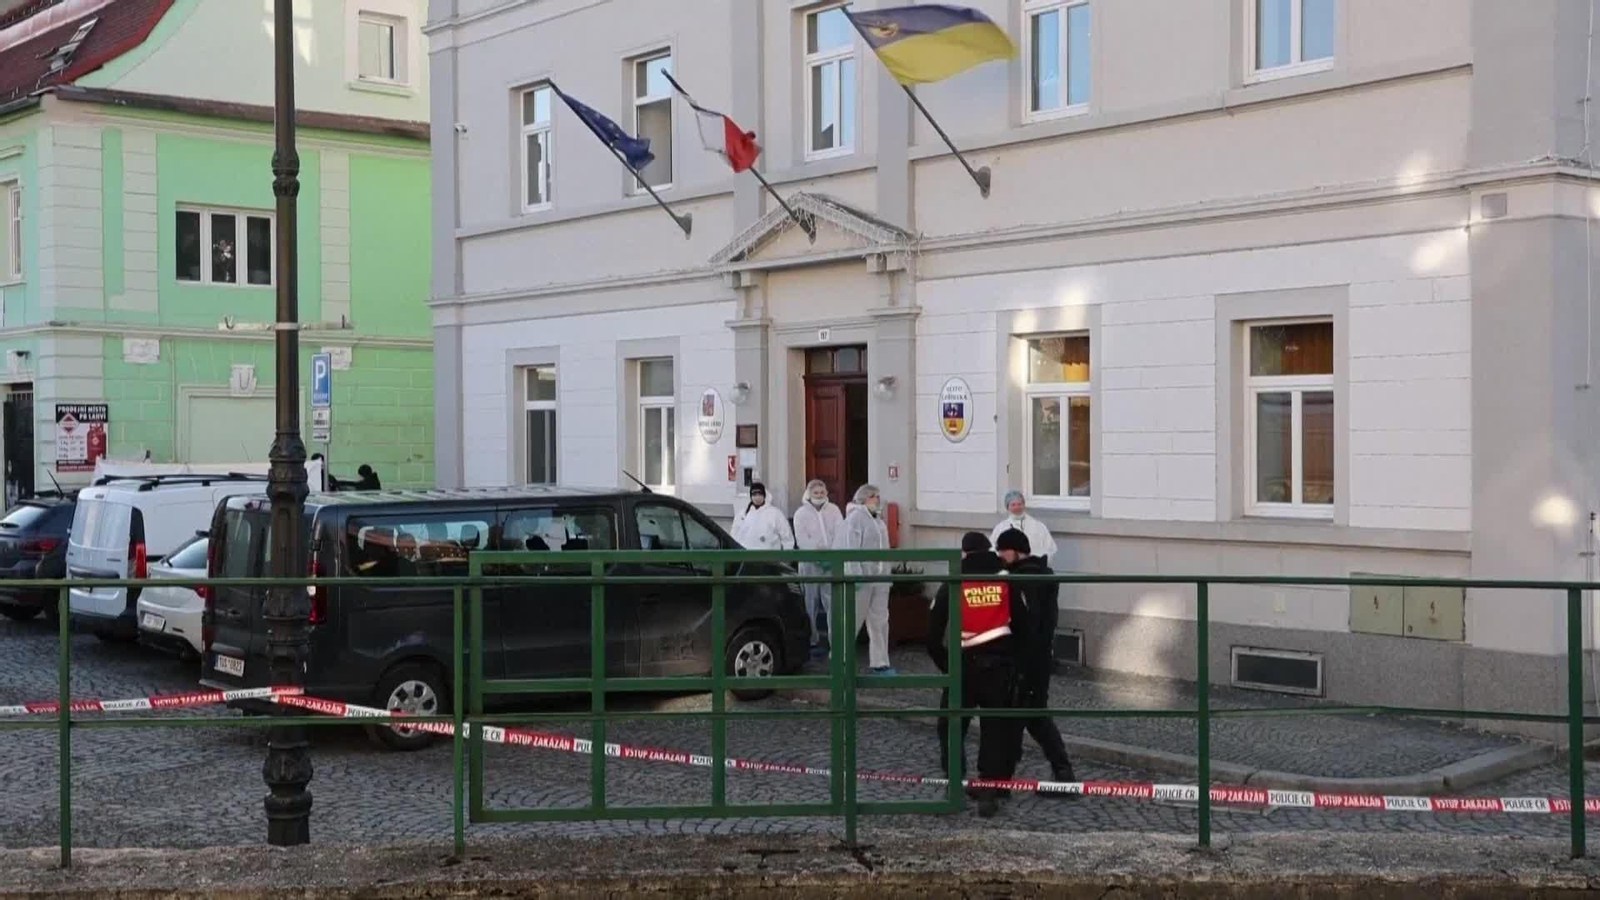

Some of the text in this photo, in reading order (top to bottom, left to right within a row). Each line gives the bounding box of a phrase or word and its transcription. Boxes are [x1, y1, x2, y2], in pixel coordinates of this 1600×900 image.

[315, 360, 326, 390] P
[964, 586, 1003, 597] POLICIE
[966, 594, 1002, 604] VELITEL
[509, 732, 533, 745] VSTUP
[624, 746, 648, 759] VSTUP
[1088, 786, 1111, 795] VSTUP
[1154, 788, 1183, 799] POLICIE
[1184, 787, 1196, 799] ČR
[1270, 793, 1299, 804] POLICIE
[1318, 794, 1342, 806] VSTUP
[1386, 798, 1416, 808] POLICIE
[1436, 799, 1459, 809] VSTUP
[1504, 799, 1533, 810] POLICIE
